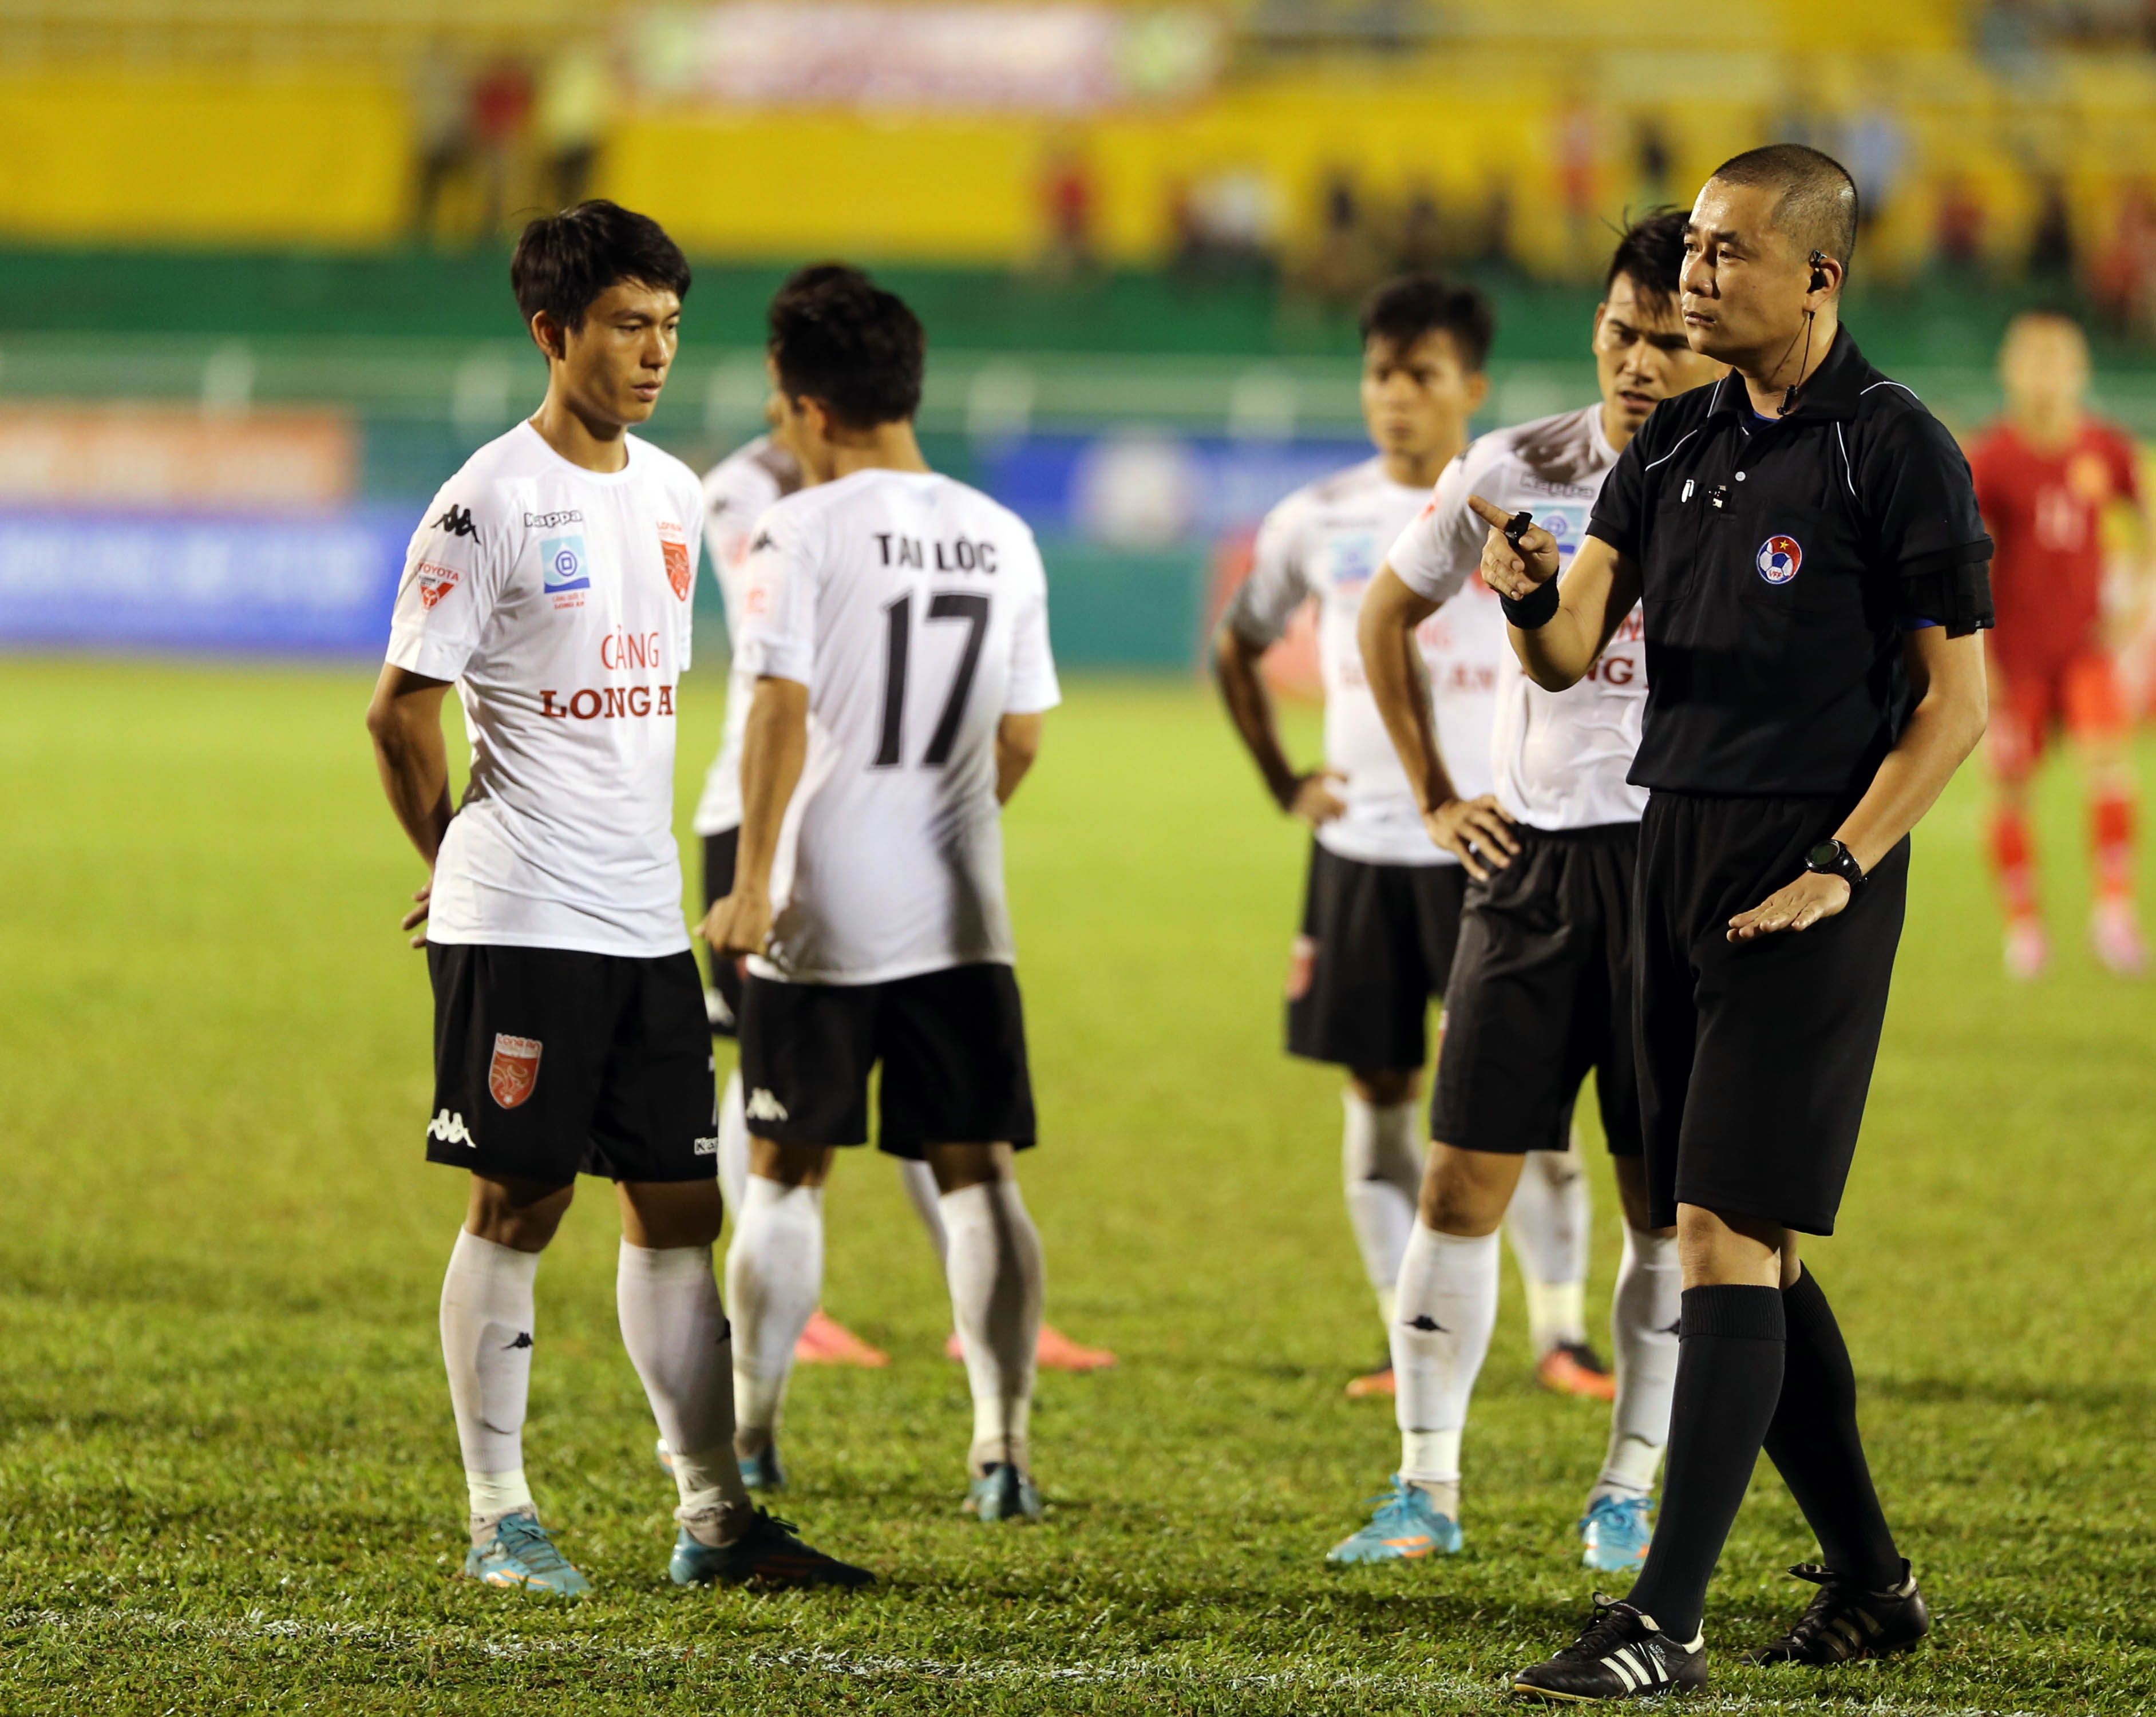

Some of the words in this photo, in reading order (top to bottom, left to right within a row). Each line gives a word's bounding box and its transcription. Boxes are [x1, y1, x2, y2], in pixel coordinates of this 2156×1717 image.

[524, 510, 583, 528] Kappa
[418, 562, 459, 582] TOYOTA
[601, 624, 659, 670] CẢNG
[867, 588, 992, 772] 17
[540, 686, 651, 720] LONG
[656, 685, 678, 716] A
